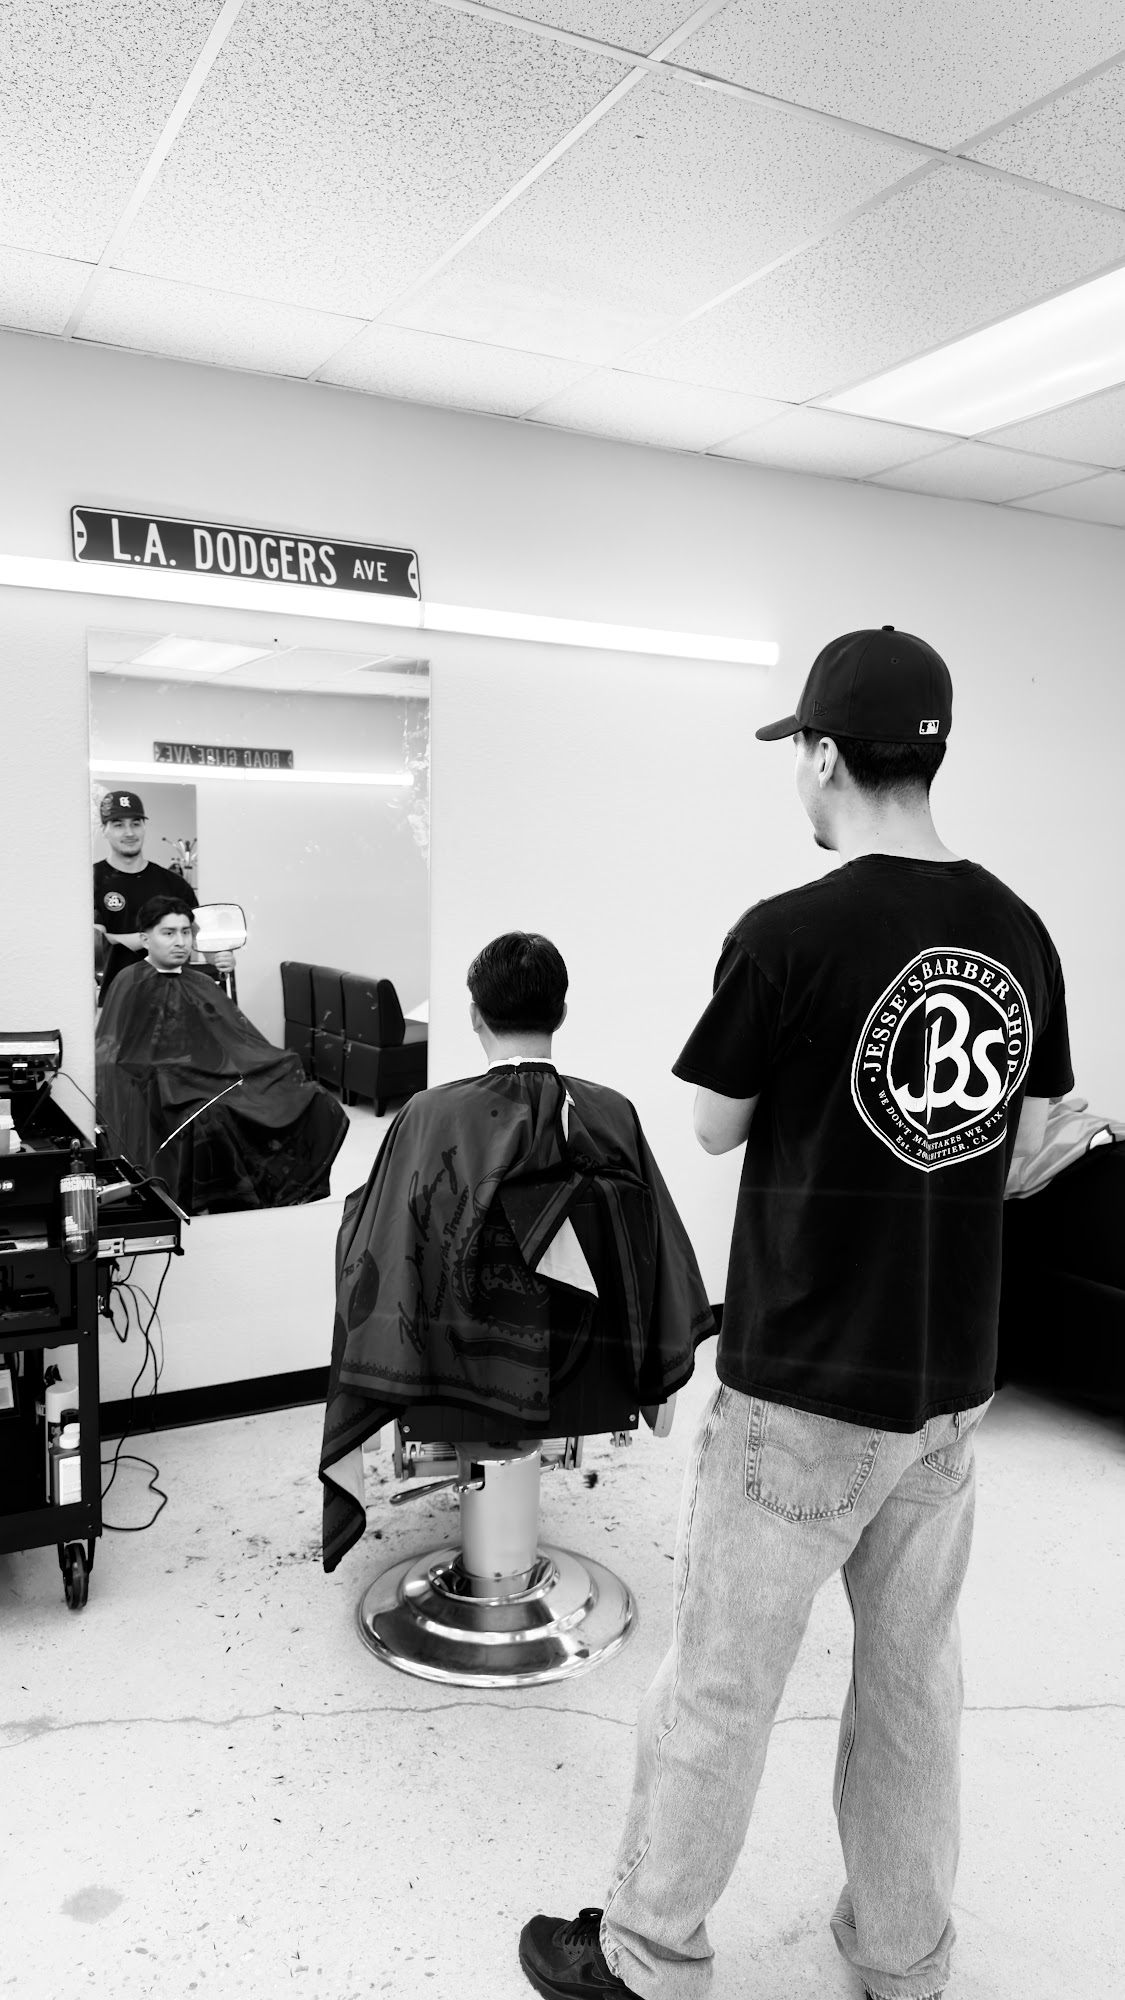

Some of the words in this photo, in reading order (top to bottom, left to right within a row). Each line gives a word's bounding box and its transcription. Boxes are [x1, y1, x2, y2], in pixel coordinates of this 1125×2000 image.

[111, 518, 177, 567] L.A.
[193, 528, 338, 586] DODGERS
[352, 558, 389, 583] AVE
[863, 974, 924, 1073] JESSE'S
[921, 958, 1010, 1001] BARBER
[1006, 1002, 1023, 1074] SHOP
[878, 1089, 890, 1106] WE
[885, 1105, 912, 1136] DON'T
[964, 1125, 983, 1138] WE
[984, 1110, 1003, 1129] FIX
[972, 1134, 989, 1146] CA
